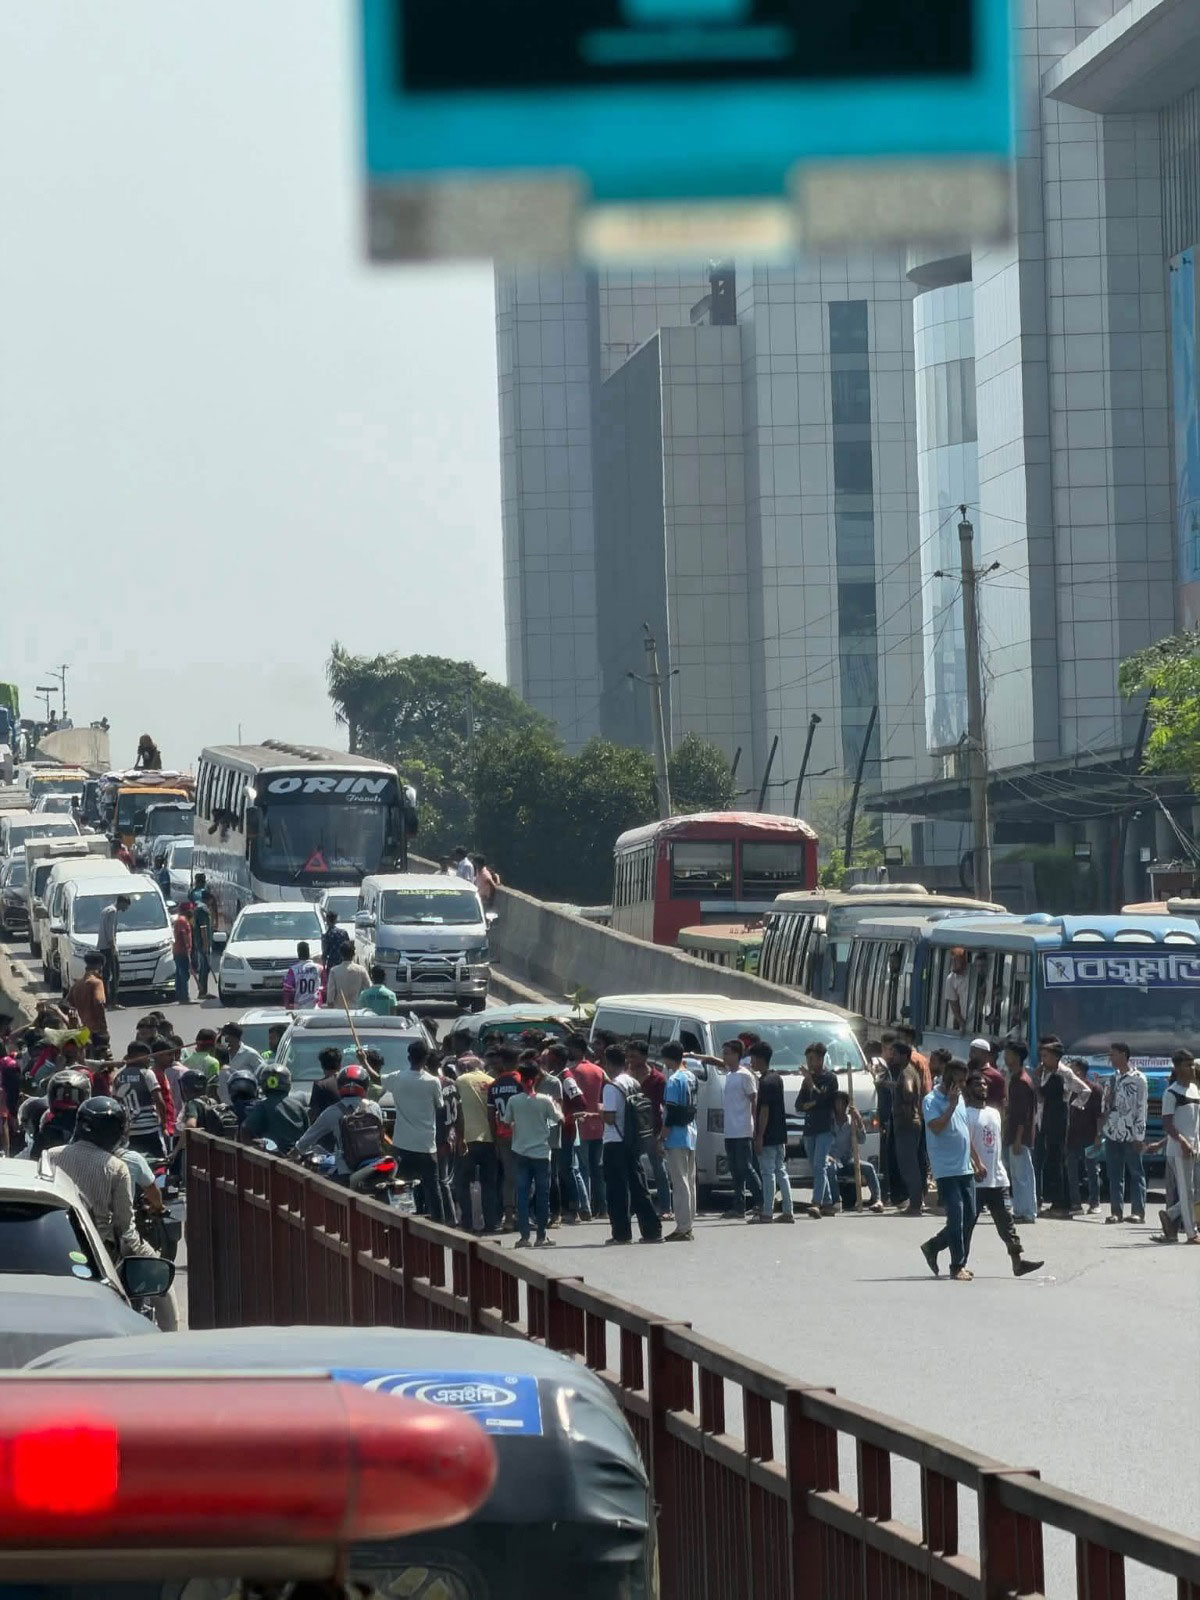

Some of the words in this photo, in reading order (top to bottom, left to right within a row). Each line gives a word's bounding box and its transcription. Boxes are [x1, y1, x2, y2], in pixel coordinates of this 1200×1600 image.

[268, 777, 388, 794] ORIN
[345, 794, 381, 802] Travels
[432, 1385, 497, 1403] এমইপি
